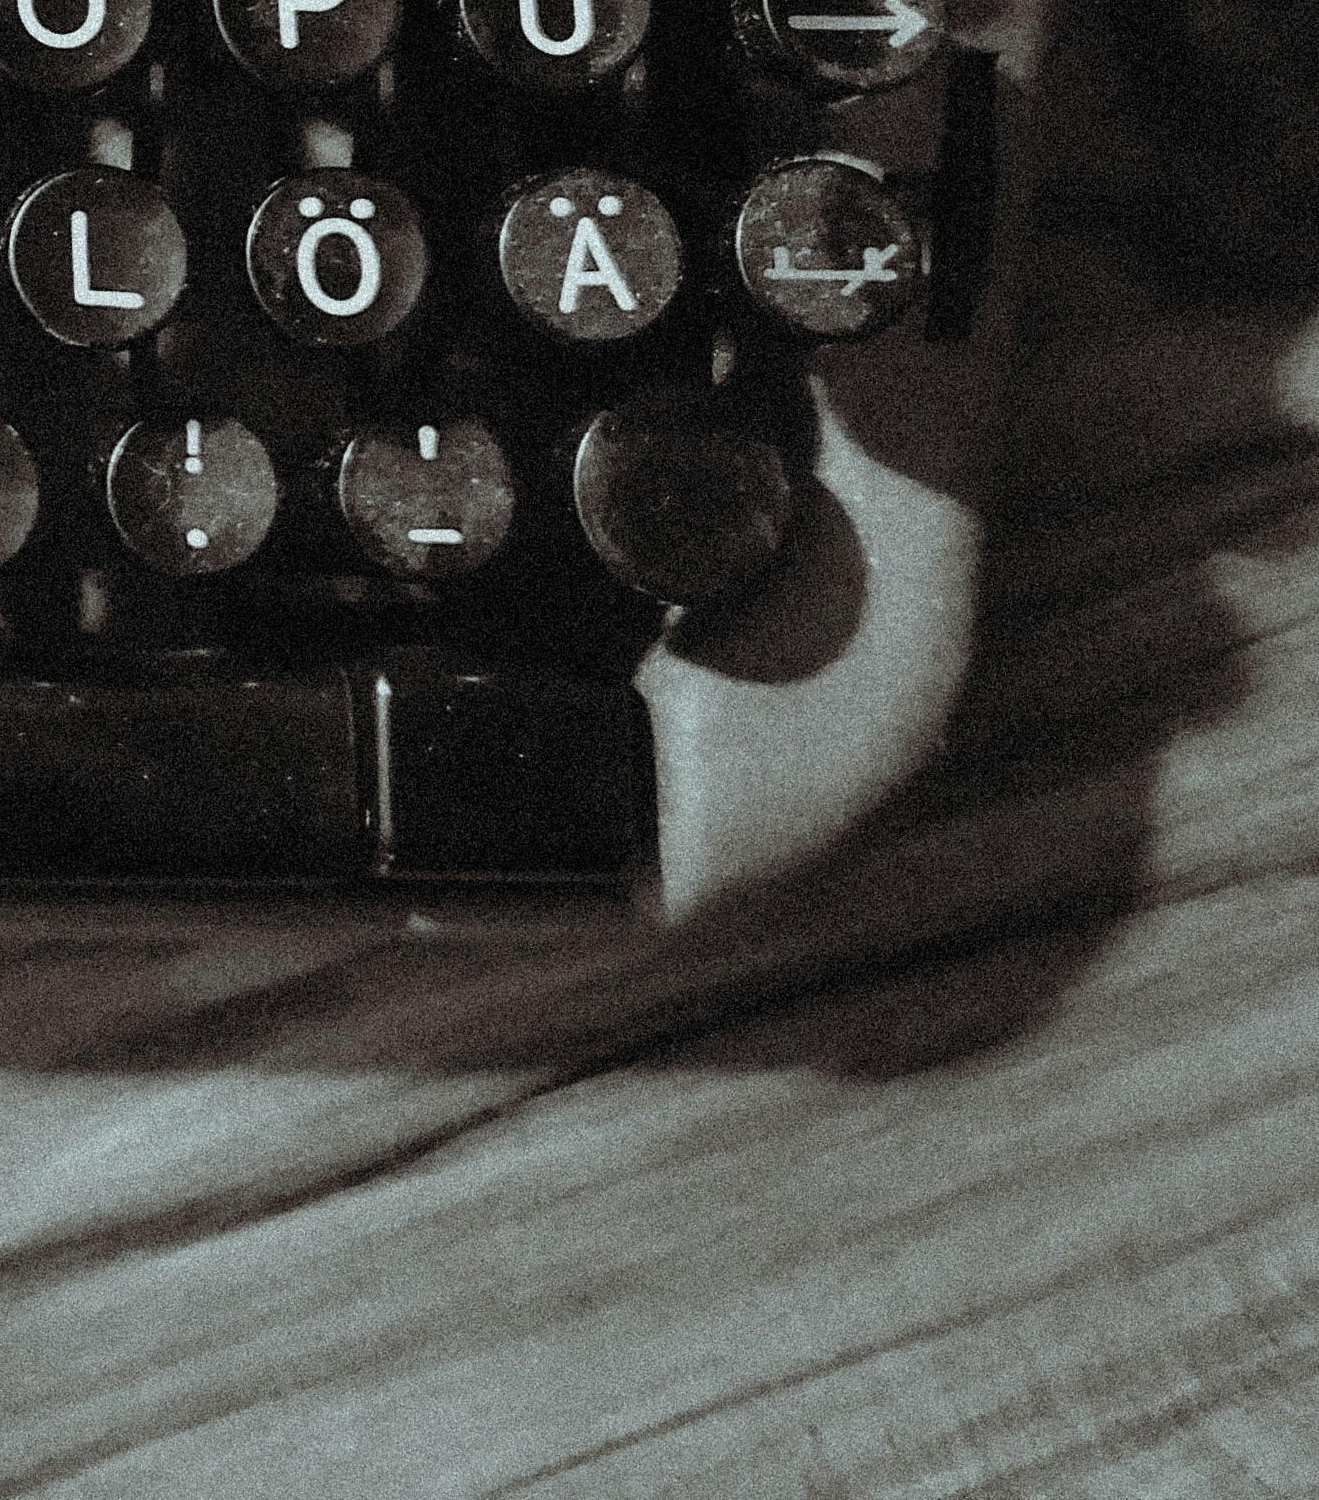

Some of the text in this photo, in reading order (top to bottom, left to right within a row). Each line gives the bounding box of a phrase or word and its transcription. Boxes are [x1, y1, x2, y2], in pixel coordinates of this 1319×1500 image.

[71, 210, 145, 308] L
[297, 196, 381, 317] Ö
[549, 195, 639, 313] Ä
[184, 419, 204, 474] !
